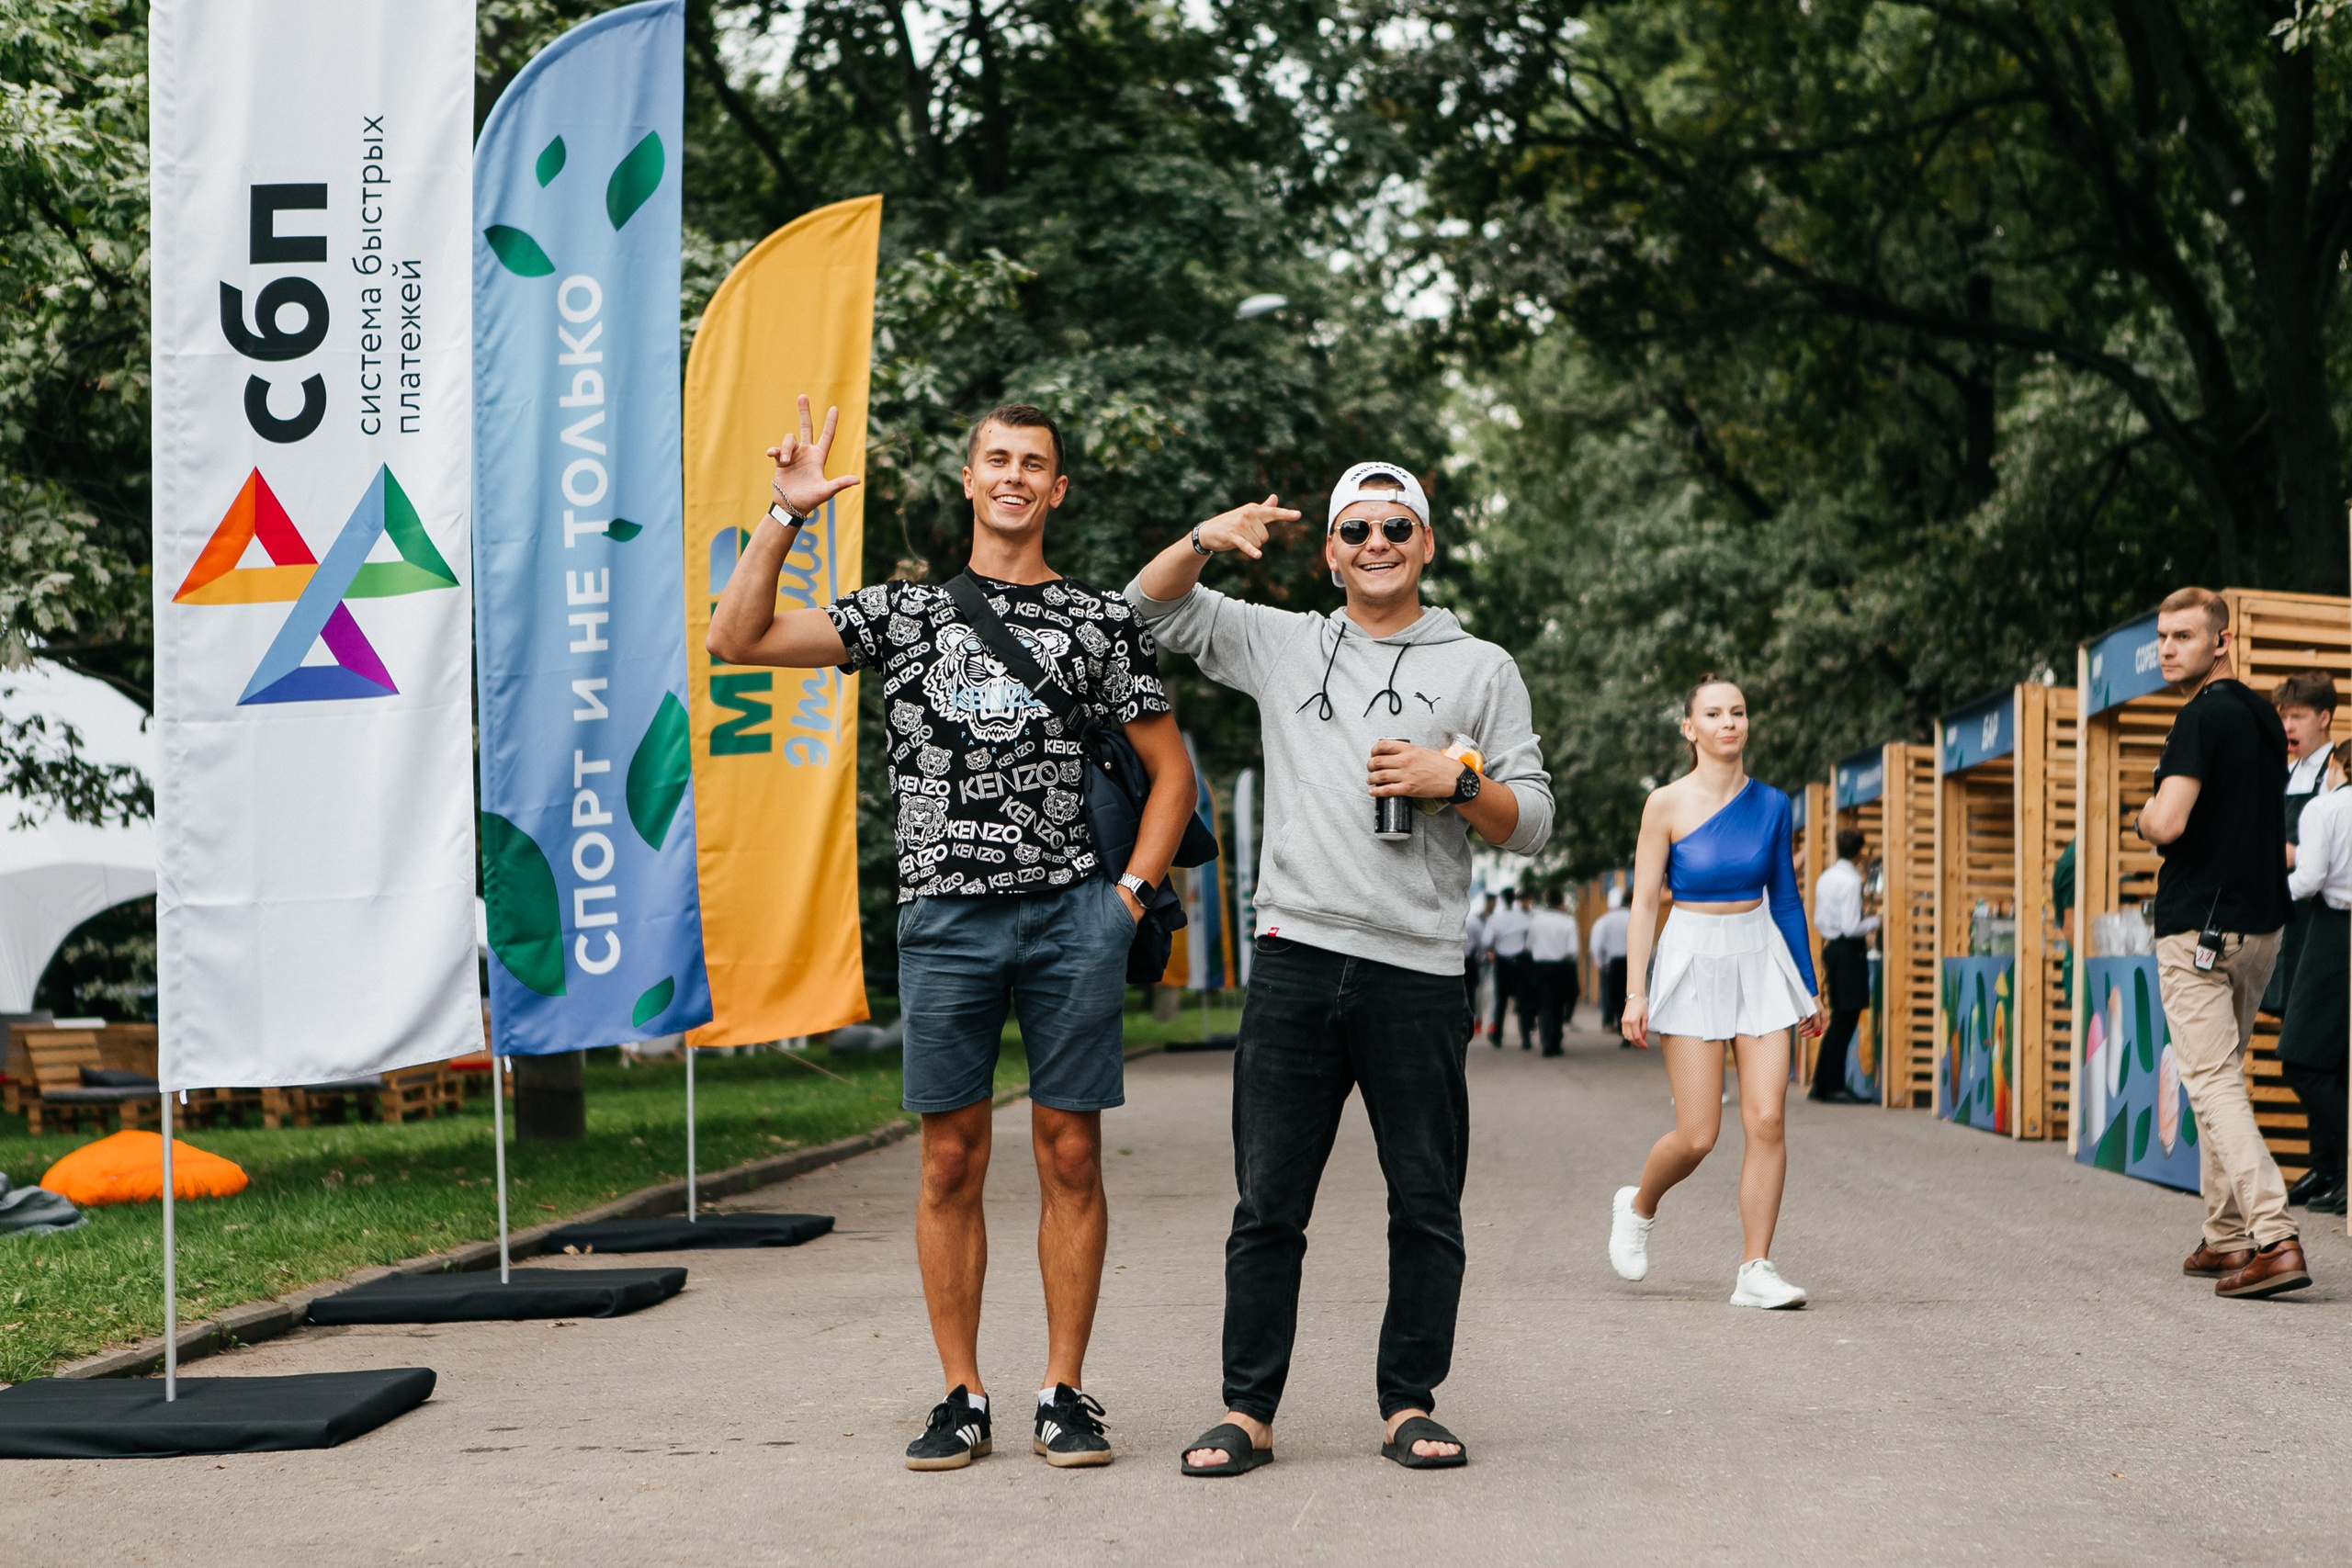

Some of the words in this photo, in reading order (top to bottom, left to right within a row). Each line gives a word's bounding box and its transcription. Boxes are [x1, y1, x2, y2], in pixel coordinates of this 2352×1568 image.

[353, 115, 391, 275] быстрых
[360, 286, 385, 436] система
[391, 259, 422, 434] платежей
[557, 274, 610, 548] ТОЛЬКО
[565, 567, 611, 653] НЕ
[1014, 602, 1073, 627] KENZO
[1069, 606, 1104, 620] KENZO
[842, 604, 876, 656] KENZO
[888, 642, 931, 671] KENZO
[571, 678, 609, 721] И
[884, 661, 924, 699] KENZO
[892, 725, 933, 764] KENZO
[995, 740, 1035, 770] KENZO
[899, 774, 951, 797] KENZO
[958, 760, 1060, 805] KENZO
[947, 819, 1023, 844] KENZO
[998, 795, 1066, 850] KENZO
[571, 750, 621, 975] СПОРТ
[952, 841, 1006, 863] KENZO
[907, 865, 937, 885] KENZO
[988, 866, 1046, 889] KENZO
